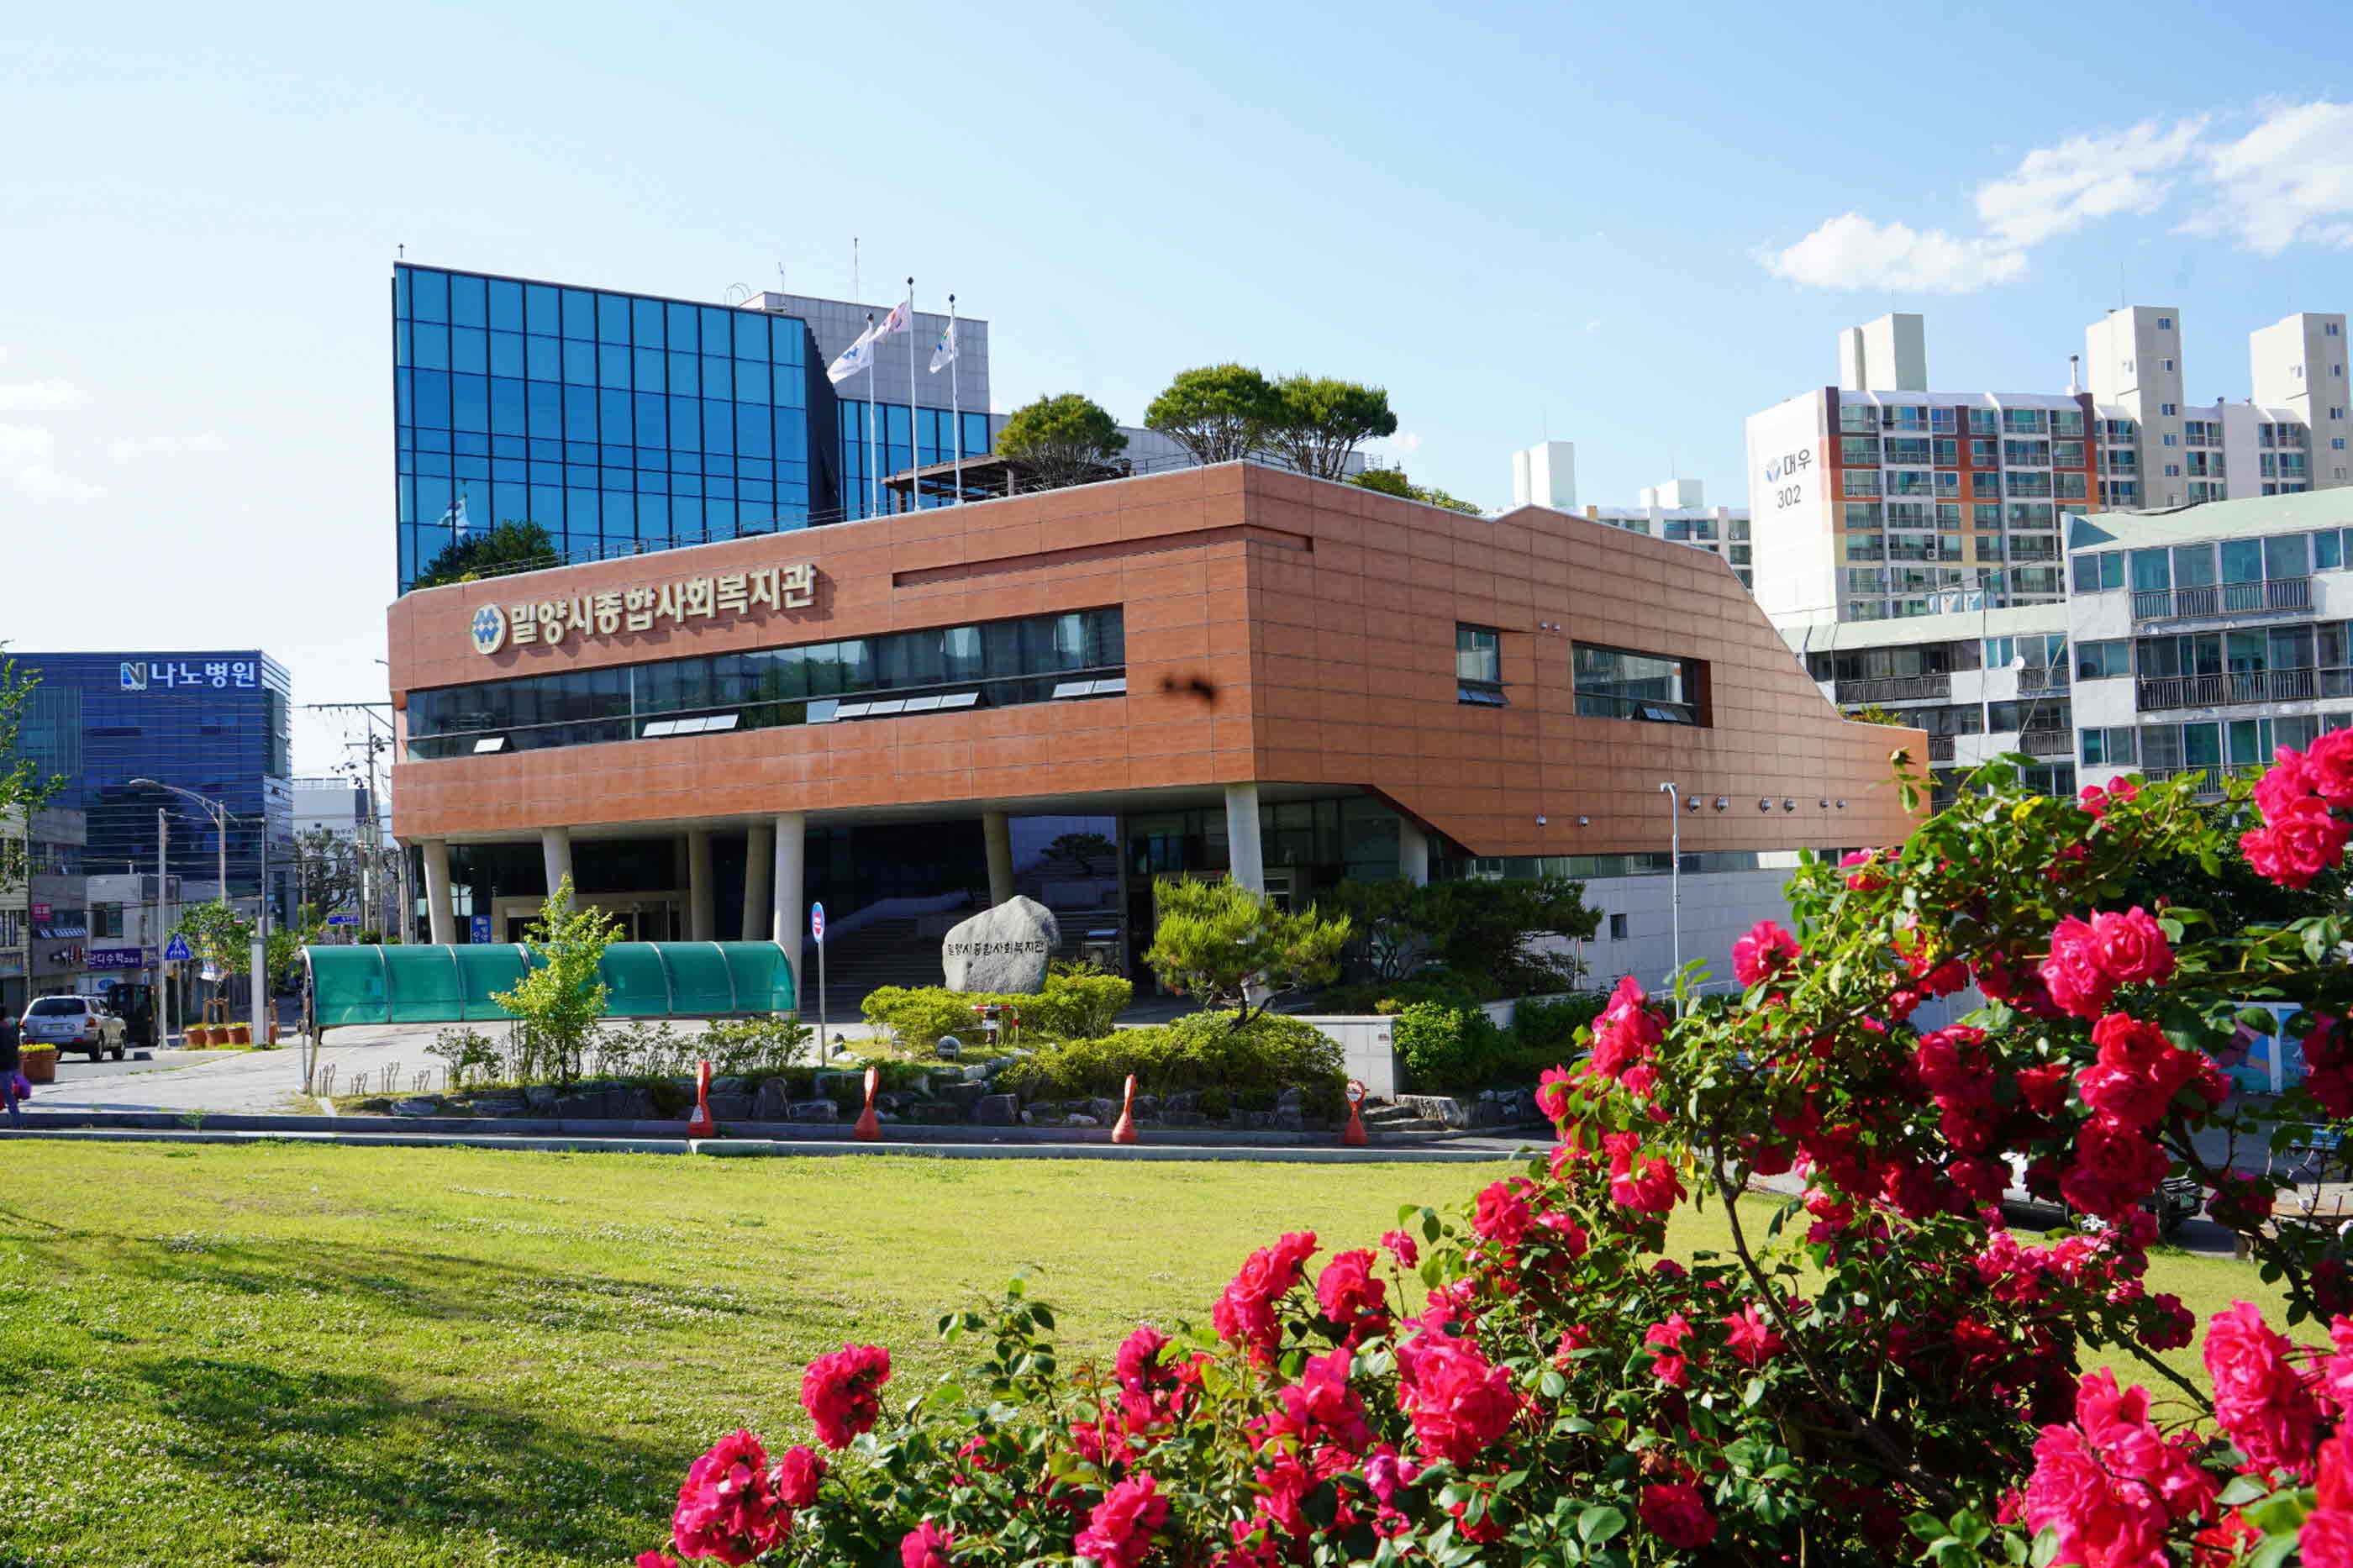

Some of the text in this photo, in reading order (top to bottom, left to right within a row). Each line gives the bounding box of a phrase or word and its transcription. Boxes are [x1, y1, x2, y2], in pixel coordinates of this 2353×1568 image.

[1784, 449, 1812, 476] 대우
[1777, 485, 1801, 509] 302
[510, 564, 818, 645] 밀양시종합사회복지관
[151, 662, 255, 688] 나노병원
[948, 940, 1045, 956] 밀양시종합사회복지관
